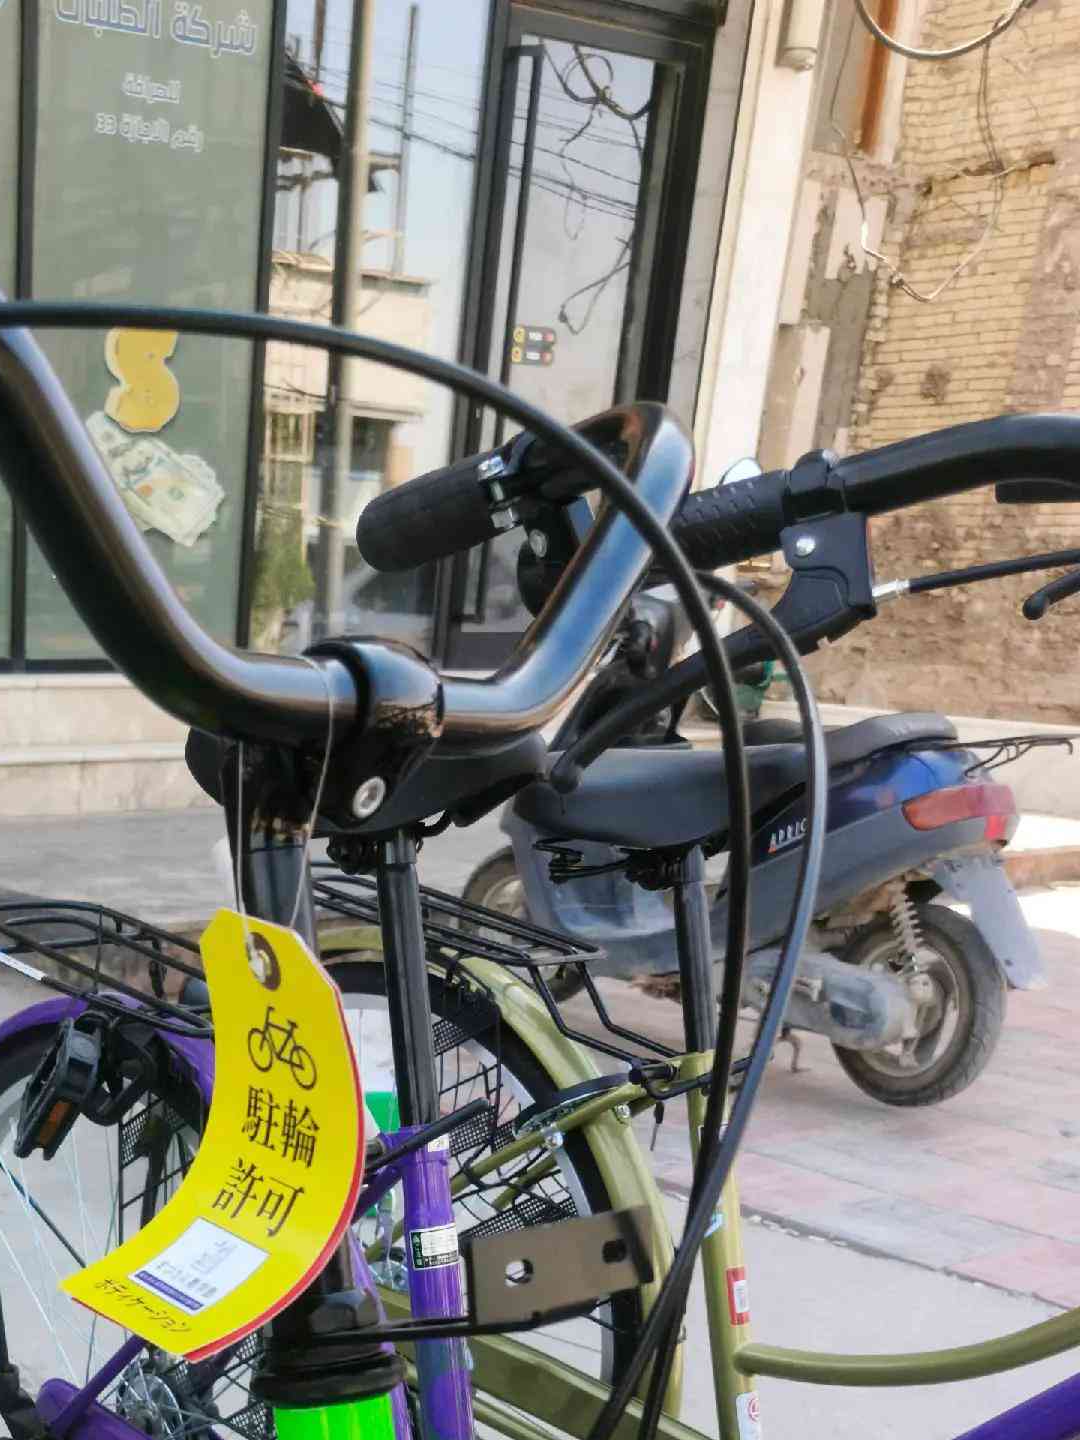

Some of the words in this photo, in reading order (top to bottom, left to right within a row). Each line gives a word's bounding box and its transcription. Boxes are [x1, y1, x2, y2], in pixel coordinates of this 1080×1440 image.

[171, 0, 257, 58] شركة
[241, 1085, 320, 1169] 駐輪
[212, 1156, 306, 1238] 許可
